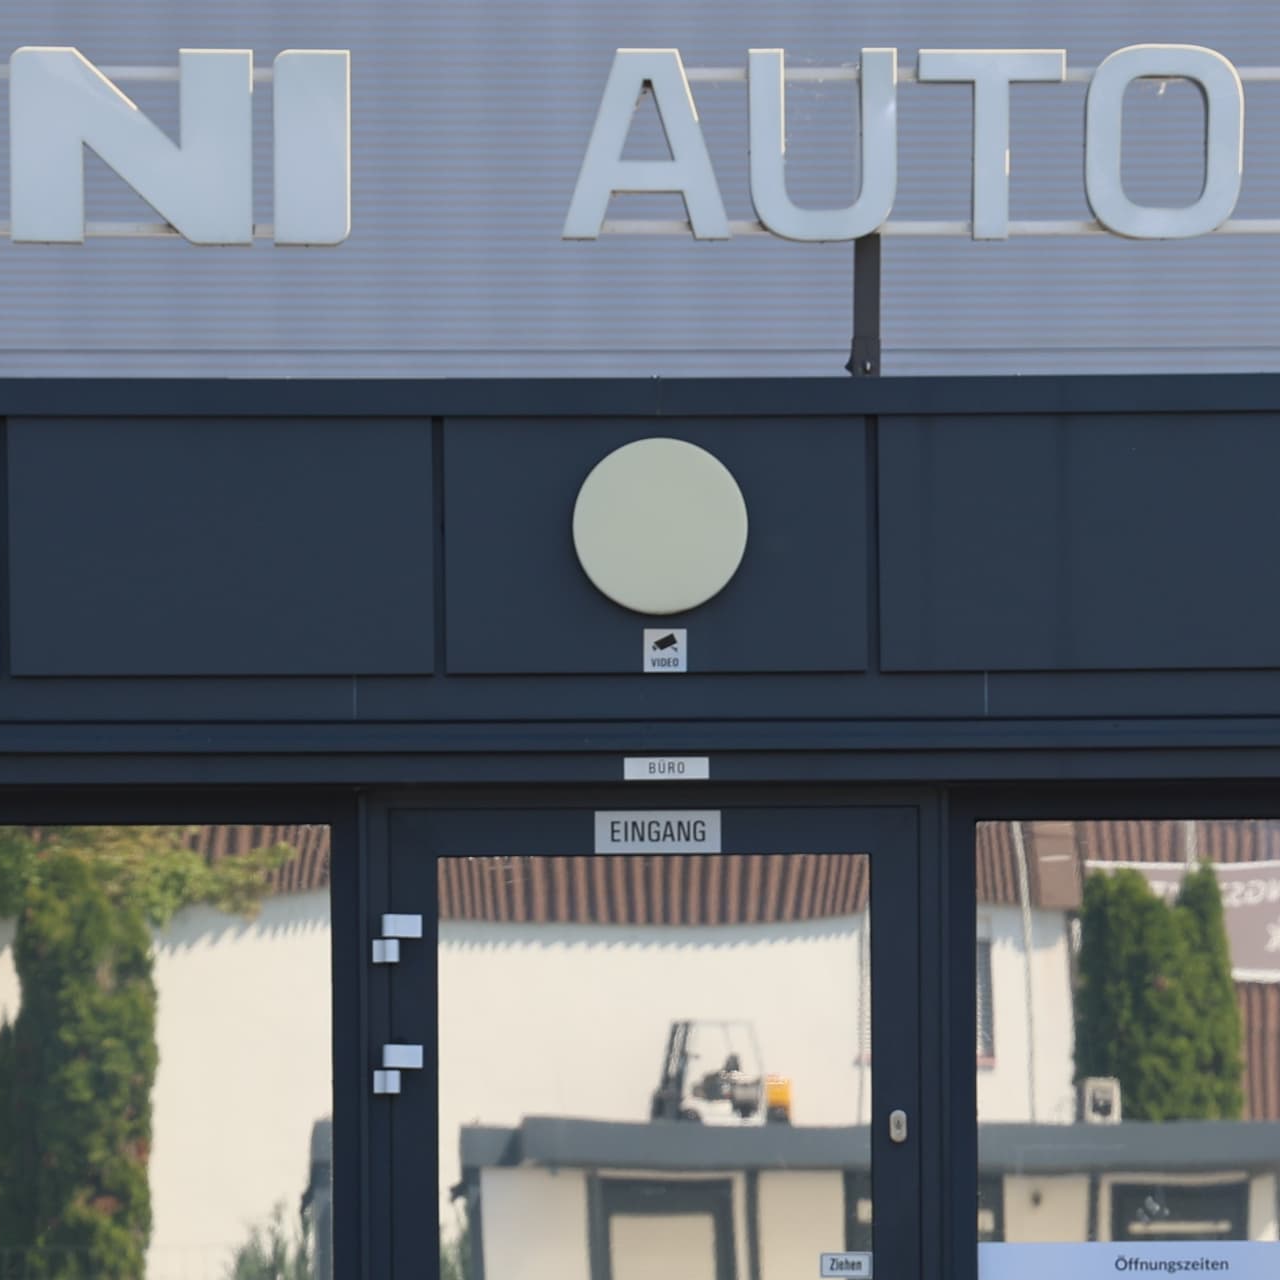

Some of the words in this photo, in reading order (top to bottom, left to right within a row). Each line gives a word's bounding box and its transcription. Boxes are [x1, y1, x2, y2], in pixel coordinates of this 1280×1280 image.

[560, 43, 1246, 243] AUTO
[650, 657, 680, 668] VIDEO
[648, 759, 686, 775] BÜRO
[610, 820, 707, 843] EINGANG
[829, 1257, 863, 1272] Ziehen
[1114, 1255, 1230, 1274] Öffnungszeiten
